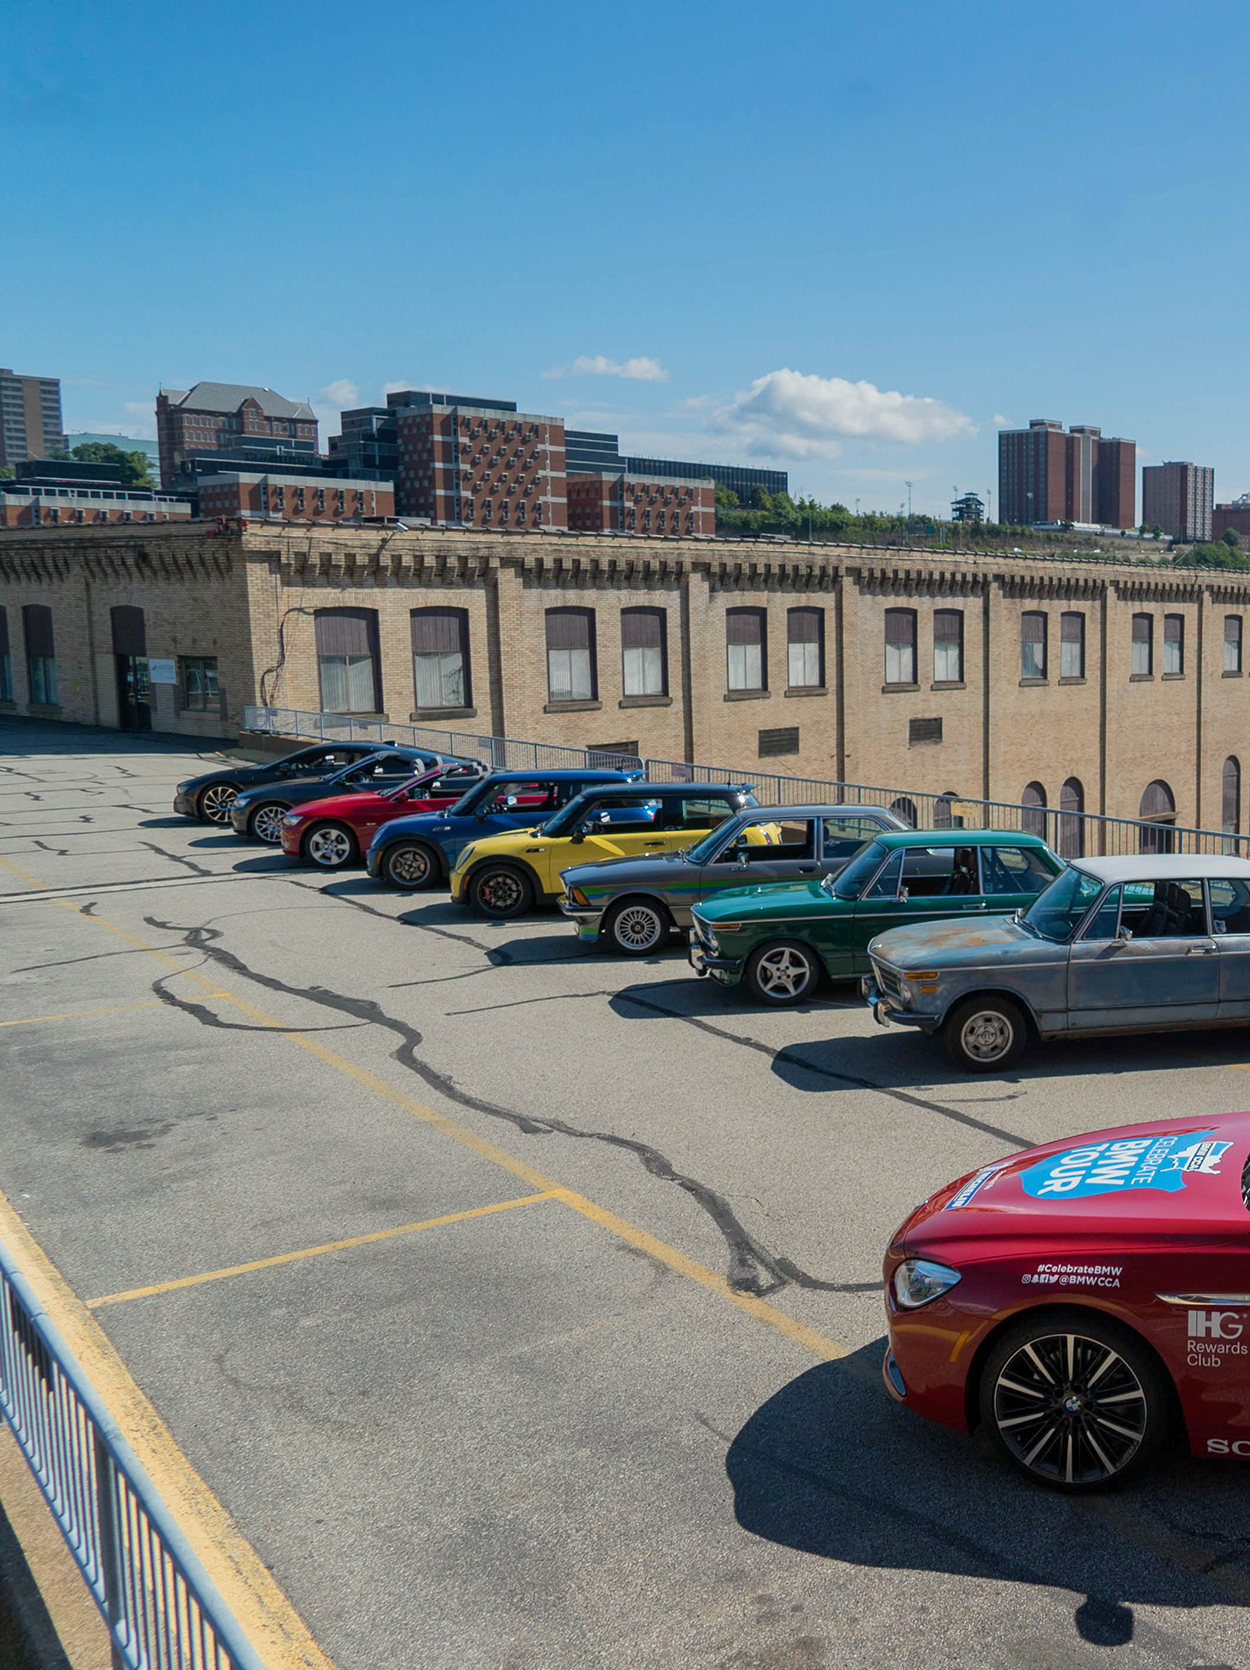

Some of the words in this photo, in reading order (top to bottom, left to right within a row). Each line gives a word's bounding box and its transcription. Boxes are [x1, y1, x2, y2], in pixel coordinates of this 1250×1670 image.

[1037, 1143, 1106, 1196] TOUR
[1085, 1139, 1153, 1185] BMW
[1131, 1137, 1178, 1185] CELEBRATE
[1037, 1264, 1123, 1276] #CelebrateBMW
[1059, 1275, 1121, 1288] @BMWCCA
[1187, 1310, 1243, 1339] IHG
[1187, 1340, 1248, 1355] Rewards
[1187, 1354, 1221, 1367] Club
